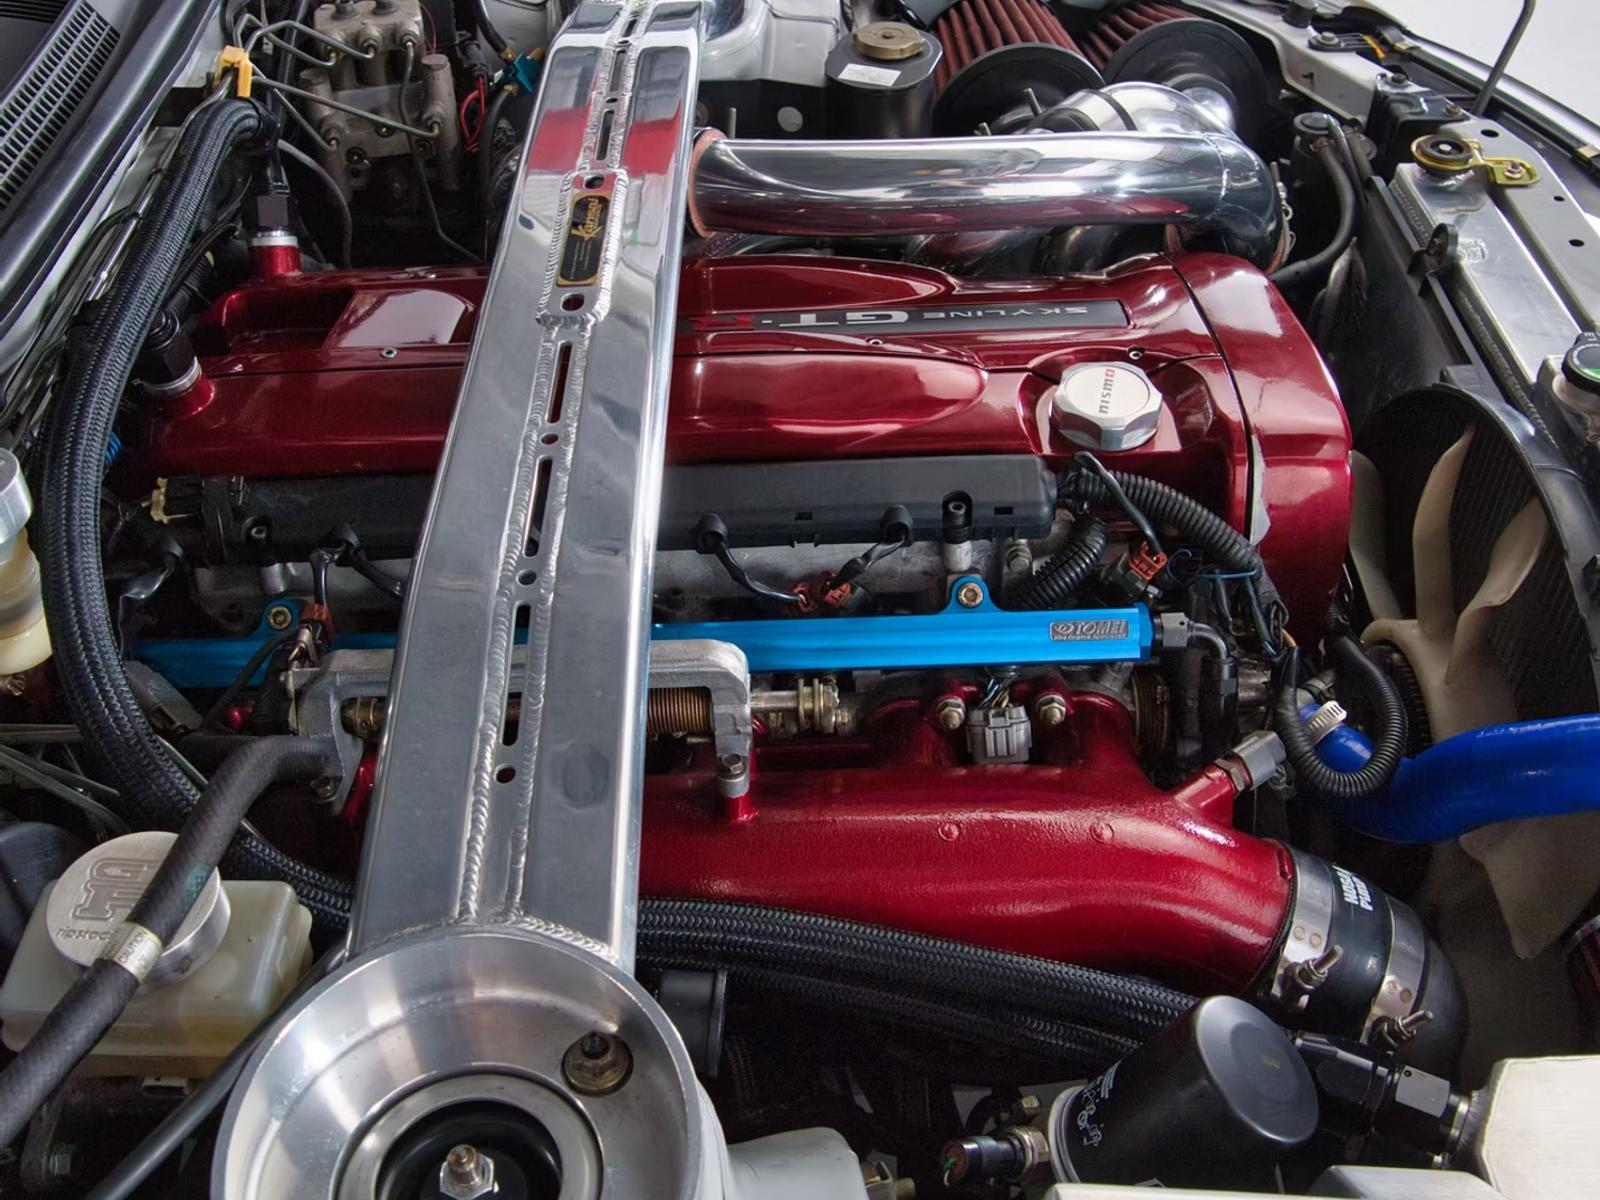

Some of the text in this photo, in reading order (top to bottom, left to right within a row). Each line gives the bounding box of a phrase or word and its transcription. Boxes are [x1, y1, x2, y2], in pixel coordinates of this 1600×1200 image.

[923, 306, 1088, 319] SKYLINE
[1098, 368, 1116, 414] nismo
[1073, 620, 1127, 635] TOMEI
